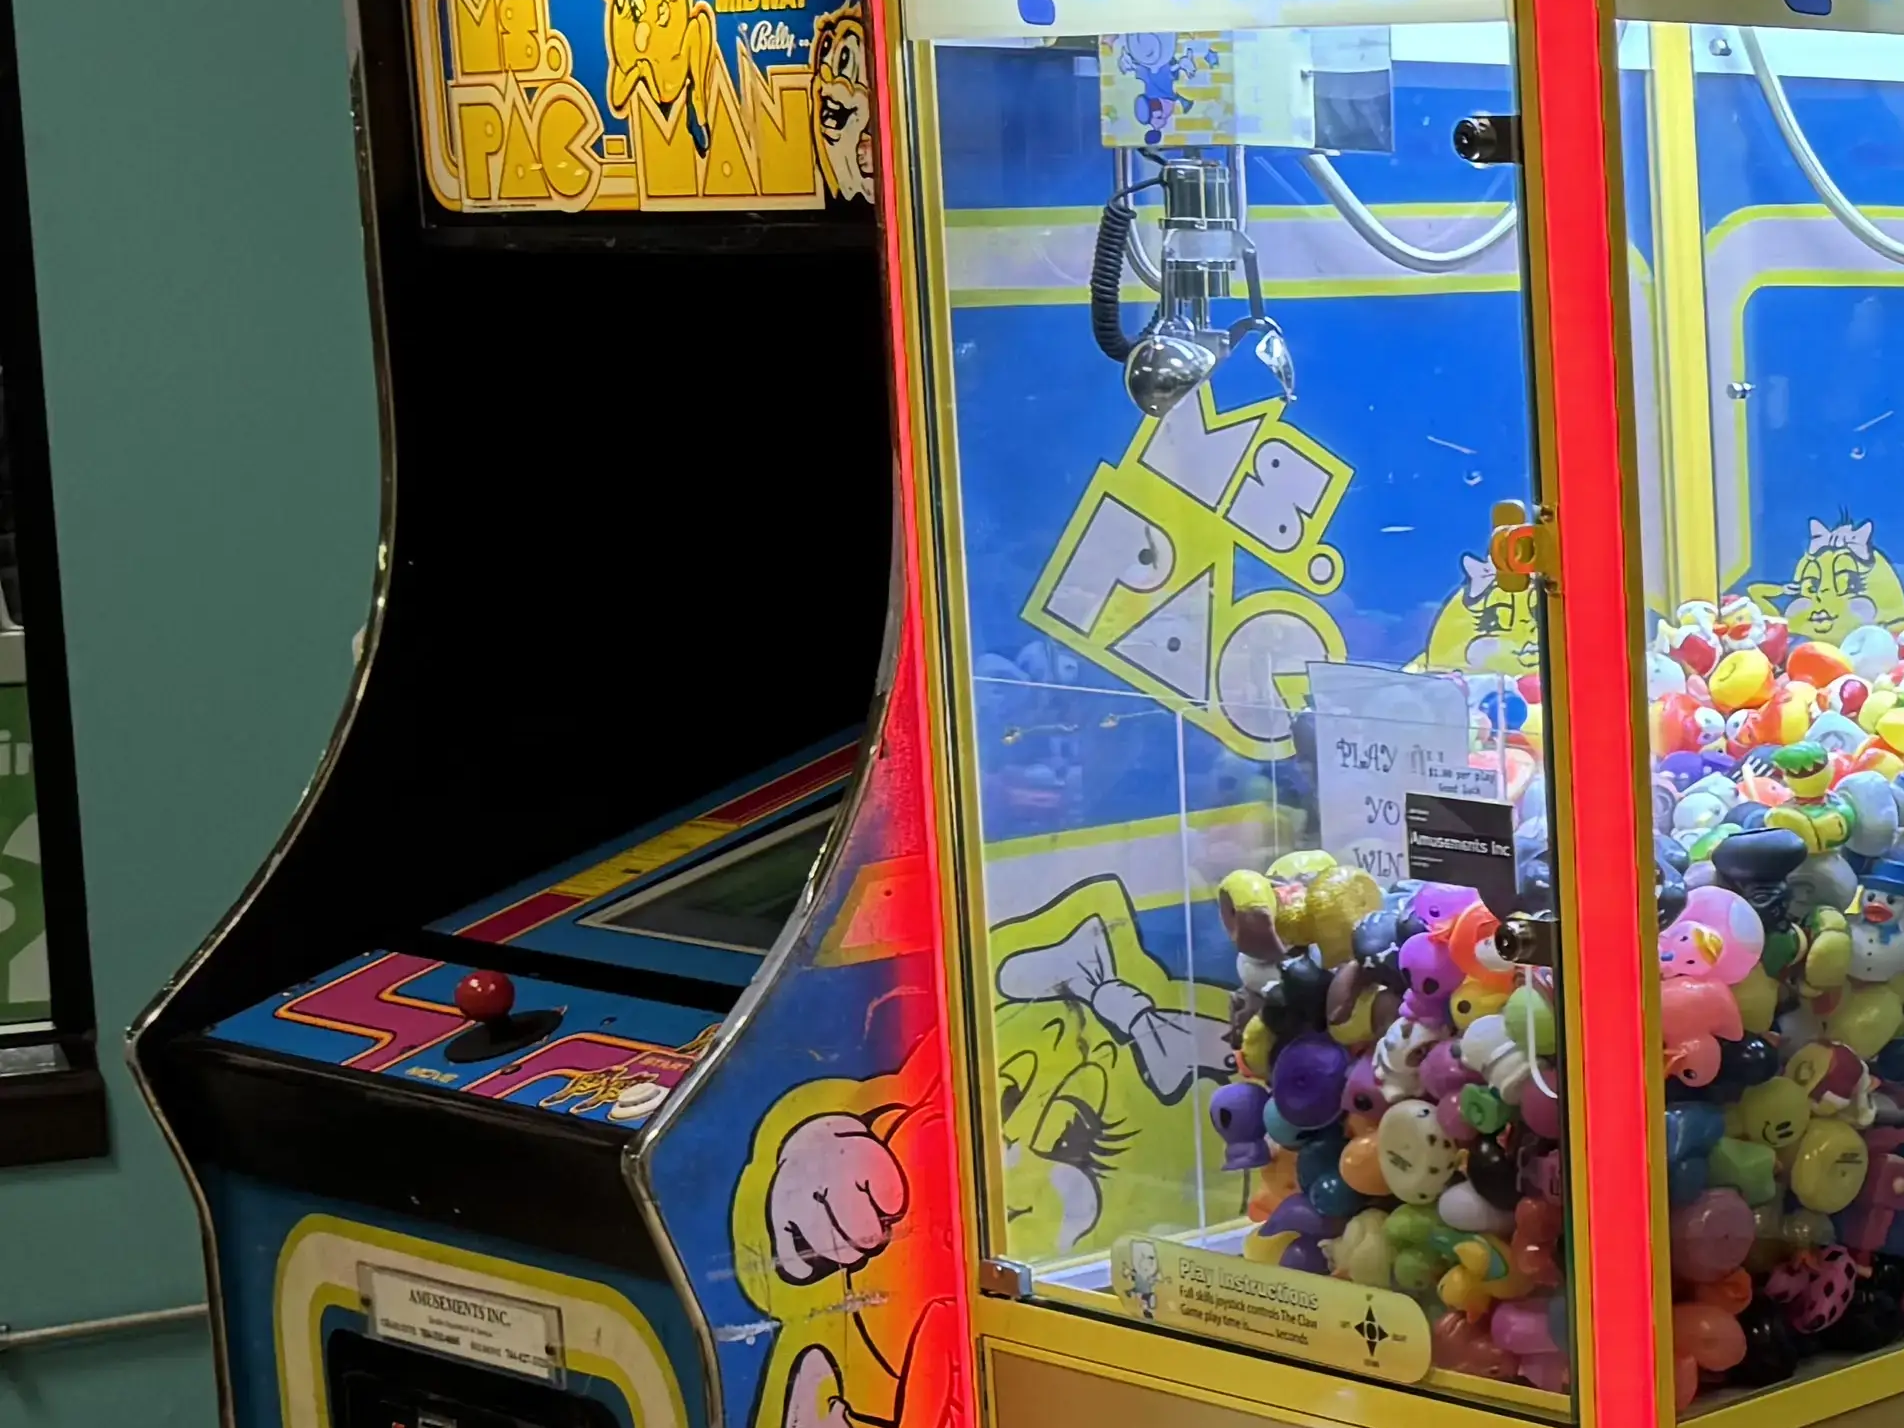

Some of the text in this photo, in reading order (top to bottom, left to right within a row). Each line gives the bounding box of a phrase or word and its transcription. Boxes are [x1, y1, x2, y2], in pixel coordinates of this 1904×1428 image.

[751, 20, 796, 58] Bally
[454, 56, 820, 206] PAC-MAN
[1335, 737, 1398, 773] PLAY
[1364, 795, 1401, 826] YO
[1409, 830, 1489, 855] Amusements
[1352, 846, 1405, 878] WIN
[1179, 1257, 1214, 1289] Play
[408, 1288, 486, 1322] AMUSEMENTS
[1204, 1310, 1222, 1327] play
